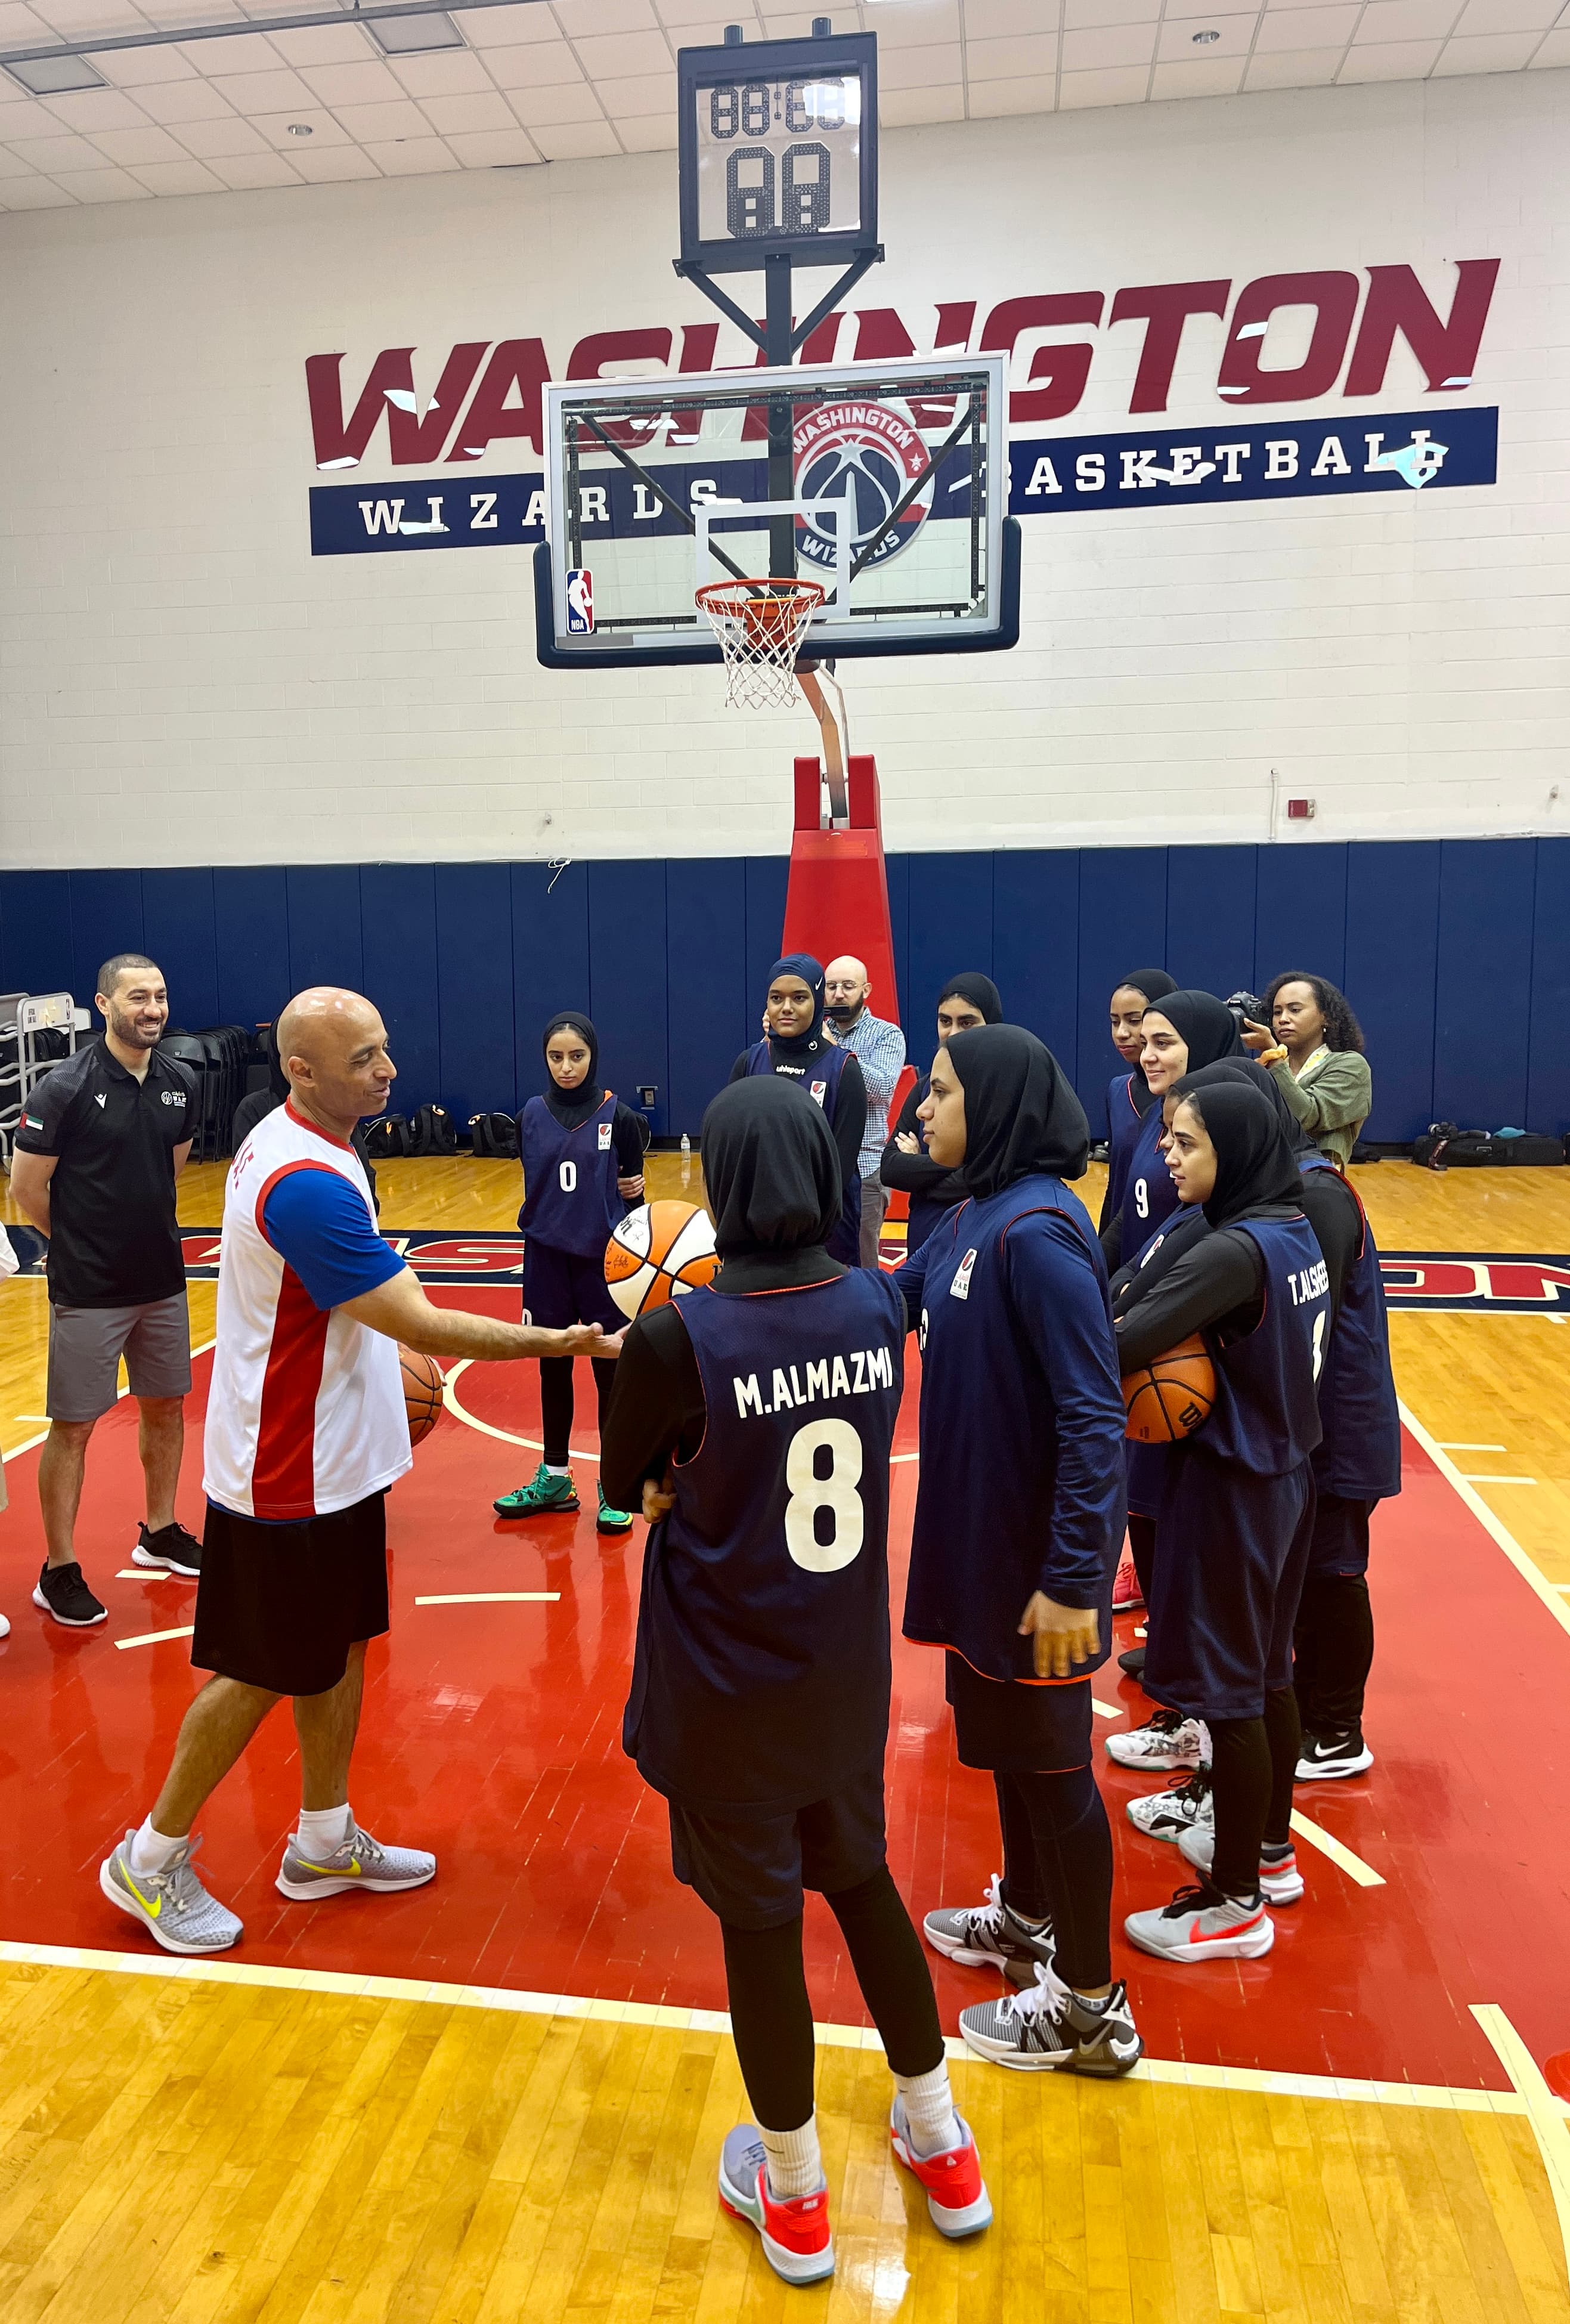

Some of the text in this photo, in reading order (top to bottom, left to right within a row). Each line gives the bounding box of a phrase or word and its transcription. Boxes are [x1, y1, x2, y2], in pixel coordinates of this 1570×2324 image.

[305, 258, 1501, 470] WASHINGTON
[794, 407, 914, 454] WASHINGTON
[571, 619, 584, 630] NBA
[776, 1064, 806, 1075] uhlsport
[559, 1161, 577, 1192] 0
[1135, 1178, 1149, 1218] 9
[733, 1347, 893, 1419] M.ALMAZMI
[784, 1418, 864, 1573] 8
